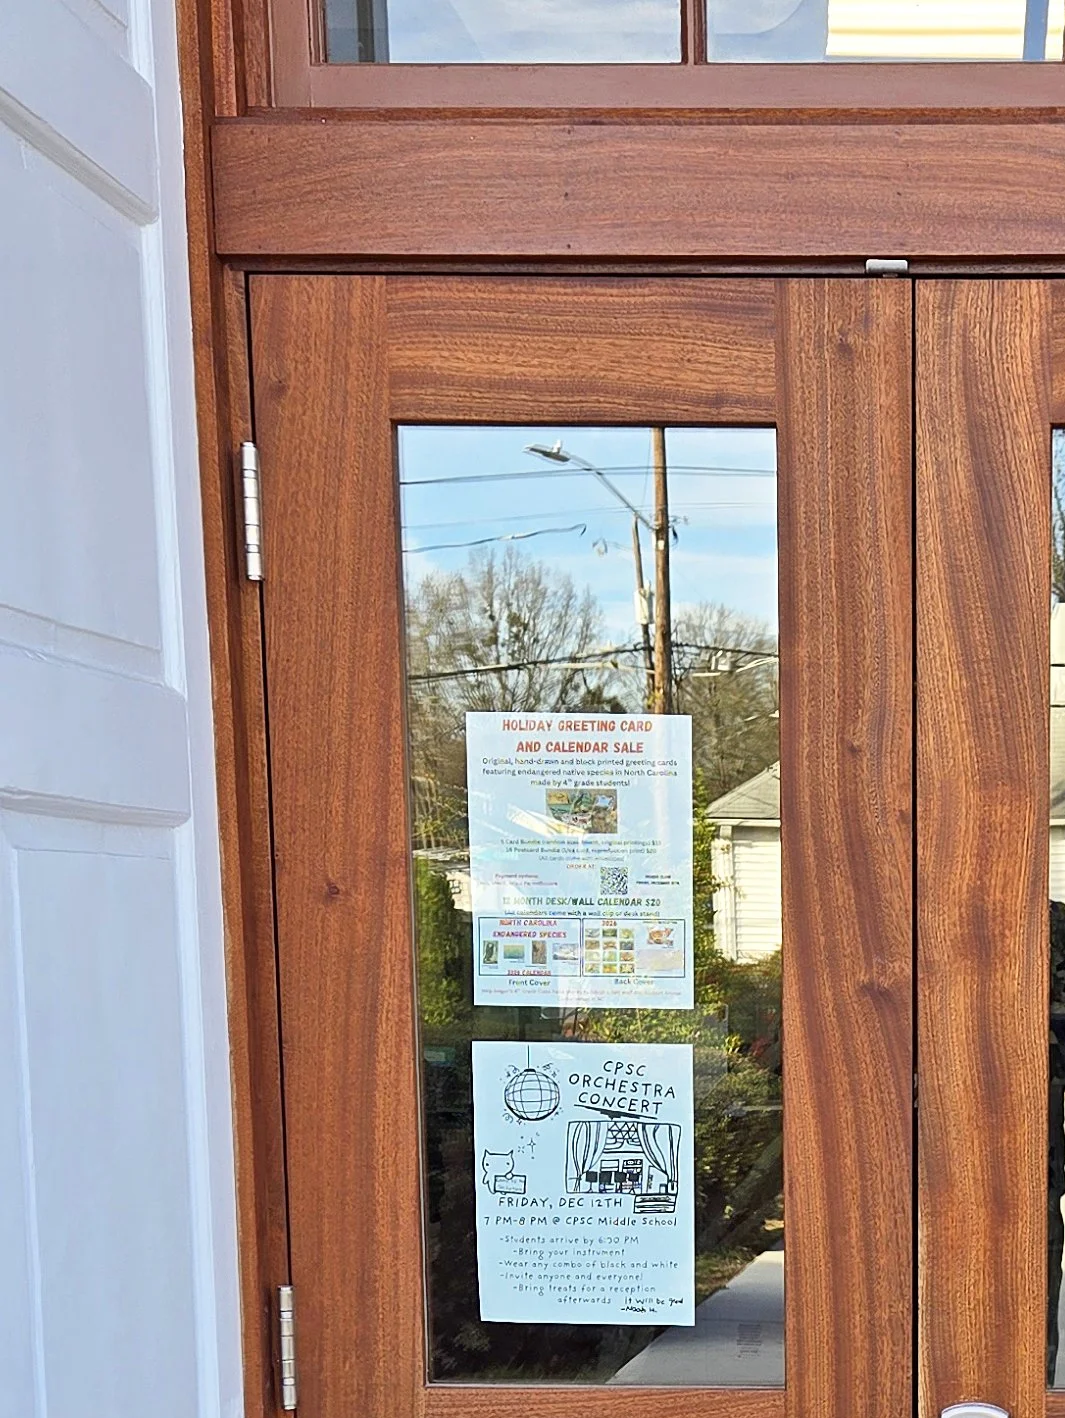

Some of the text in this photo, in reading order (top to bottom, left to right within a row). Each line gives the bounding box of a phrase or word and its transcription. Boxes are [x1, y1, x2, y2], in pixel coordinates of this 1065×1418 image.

[502, 720, 652, 732] HOLIDAY GREETING CARD
[516, 741, 643, 753] AND CALENDAR SALE
[482, 758, 513, 766] Original,
[626, 759, 656, 767] greeting
[482, 768, 516, 777] featuring
[517, 769, 561, 777] endangered
[587, 769, 614, 777] species
[553, 779, 561, 787] by
[574, 780, 594, 788] grade
[514, 898, 543, 906] MONTH
[546, 898, 595, 906] DESK/WALL
[598, 898, 642, 906] CALENDAR
[603, 1061, 647, 1077] CPSC
[569, 1074, 675, 1098] ORCHESTRA
[578, 1092, 662, 1114] CONCERT
[498, 1197, 622, 1209] FRIDAY, DEC 12TH
[484, 1217, 489, 1225] 7
[495, 1217, 525, 1225] PM-8
[552, 1217, 561, 1225] @
[566, 1217, 593, 1225] CPSC
[598, 1218, 636, 1226] Middle
[642, 1218, 677, 1226] School
[550, 1236, 579, 1244] arrive
[583, 1236, 594, 1246] by
[548, 1250, 569, 1258] your
[573, 1248, 625, 1256] instrument
[600, 1261, 626, 1269] black
[631, 1261, 648, 1269] and
[652, 1261, 678, 1269] white
[537, 1274, 572, 1282] anyone
[581, 1285, 596, 1293] for
[609, 1285, 656, 1295] reception
[558, 1296, 611, 1304] afterwards
